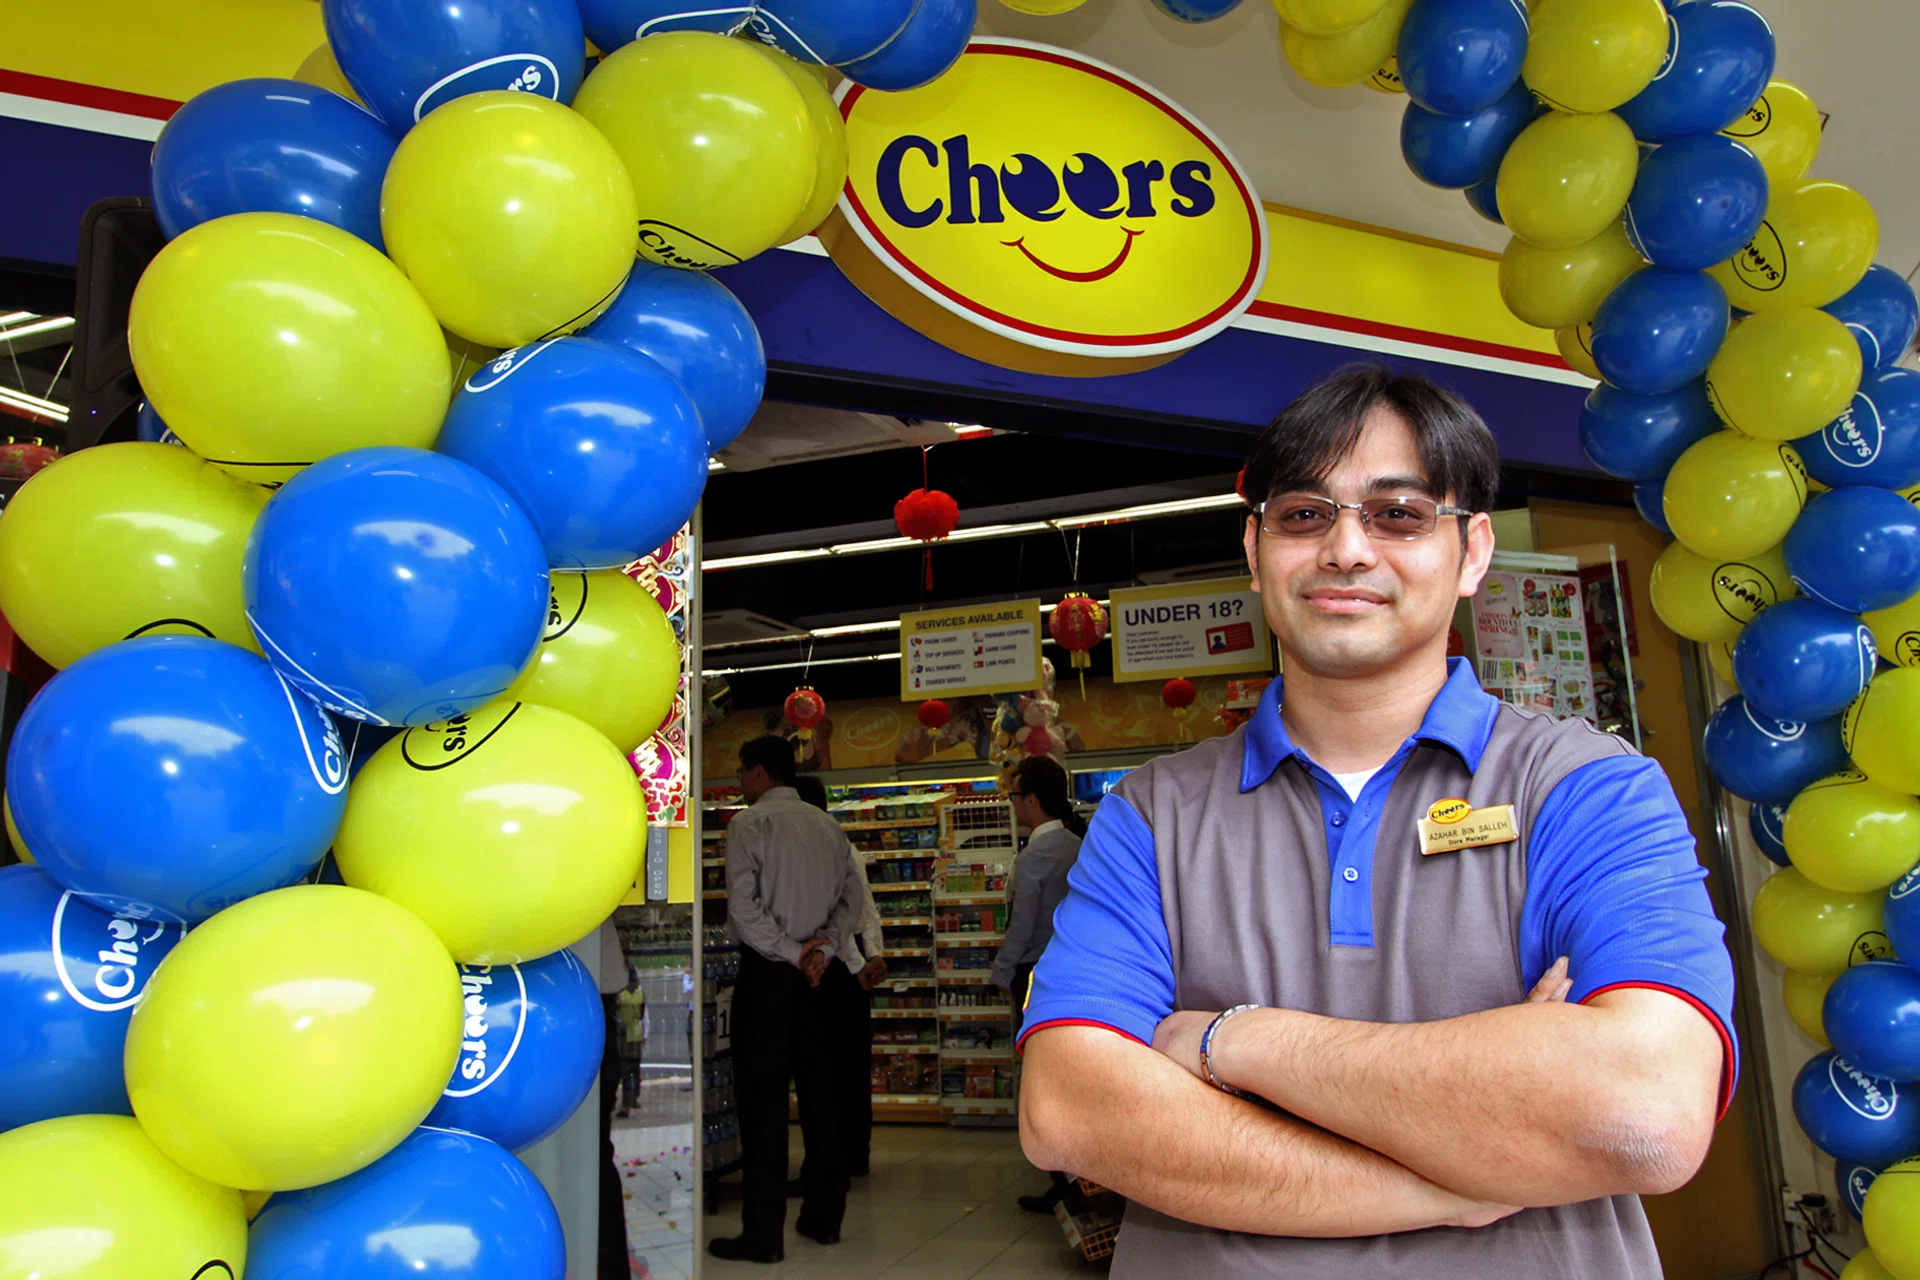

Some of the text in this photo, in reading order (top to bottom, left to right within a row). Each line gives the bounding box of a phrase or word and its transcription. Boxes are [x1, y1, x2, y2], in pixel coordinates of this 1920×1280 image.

[876, 134, 1215, 228] Cheers
[1838, 407, 1872, 458] heers
[1717, 575, 1768, 612] heers
[915, 610, 1023, 630] SERVICES AVAILABLE
[1125, 604, 1201, 626] UNDER
[1208, 599, 1243, 618] 18?
[1432, 804, 1465, 819] Cheers
[1429, 822, 1507, 841] AZAHAR BIN SALLEH
[1466, 834, 1490, 843] Manager
[653, 870, 662, 895] OPEN
